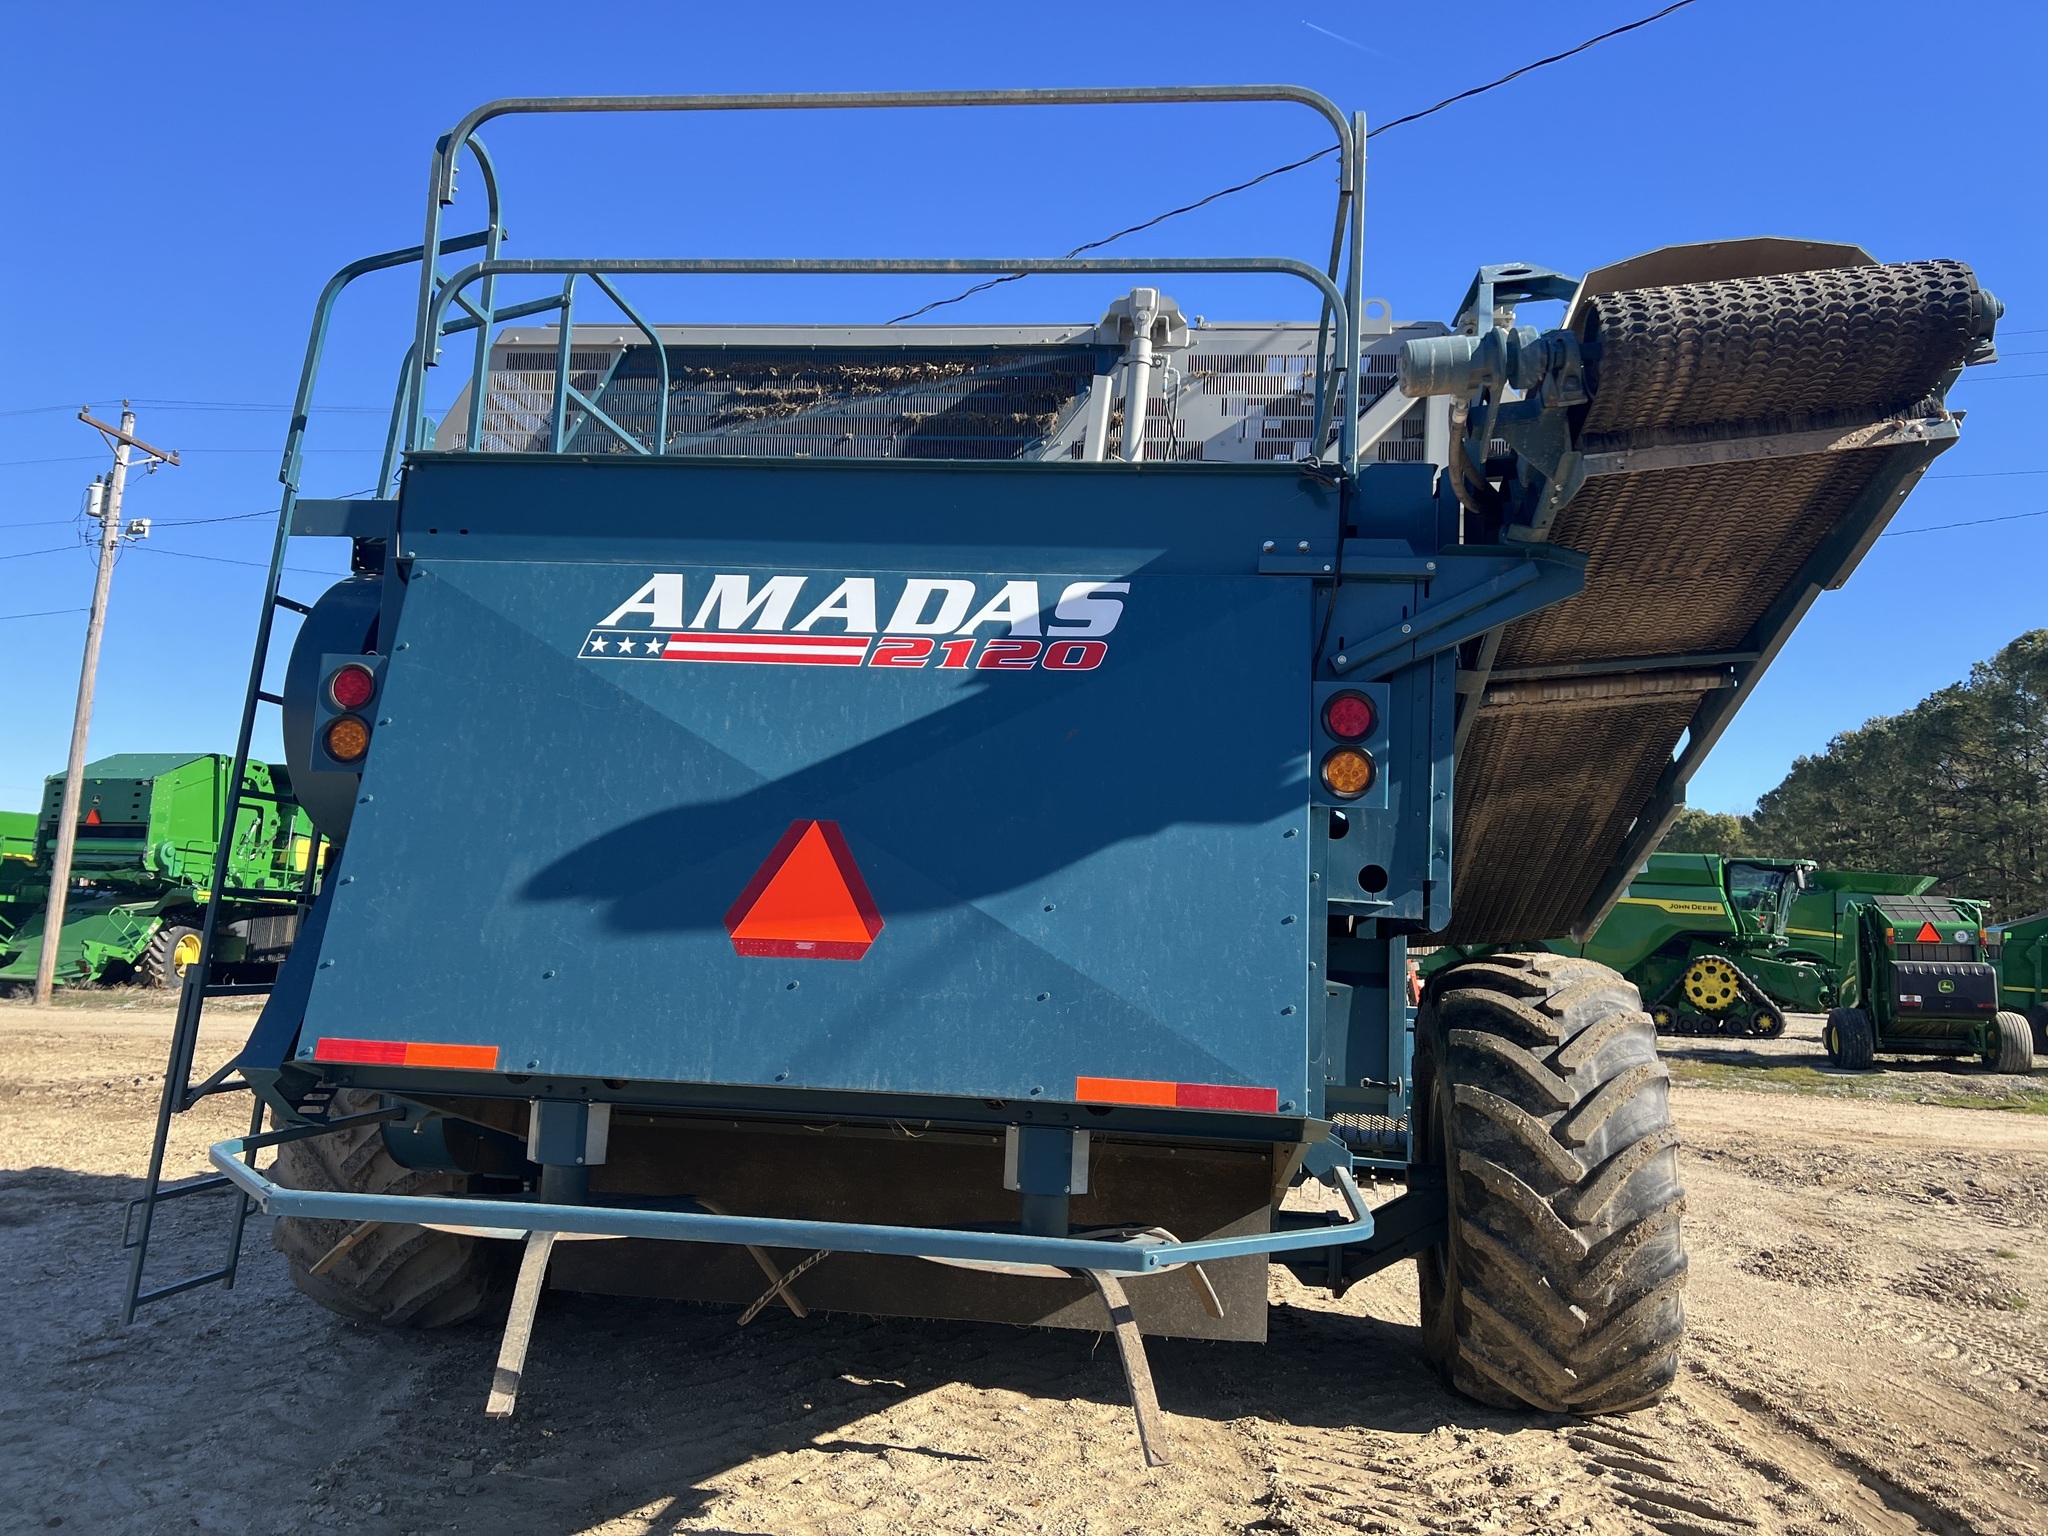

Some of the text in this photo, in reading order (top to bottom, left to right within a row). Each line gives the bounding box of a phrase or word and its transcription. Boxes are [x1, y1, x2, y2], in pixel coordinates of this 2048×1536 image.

[596, 572, 1131, 638] AMADAS
[868, 636, 1109, 671] 2120
[1691, 903, 1718, 911] DEERE
